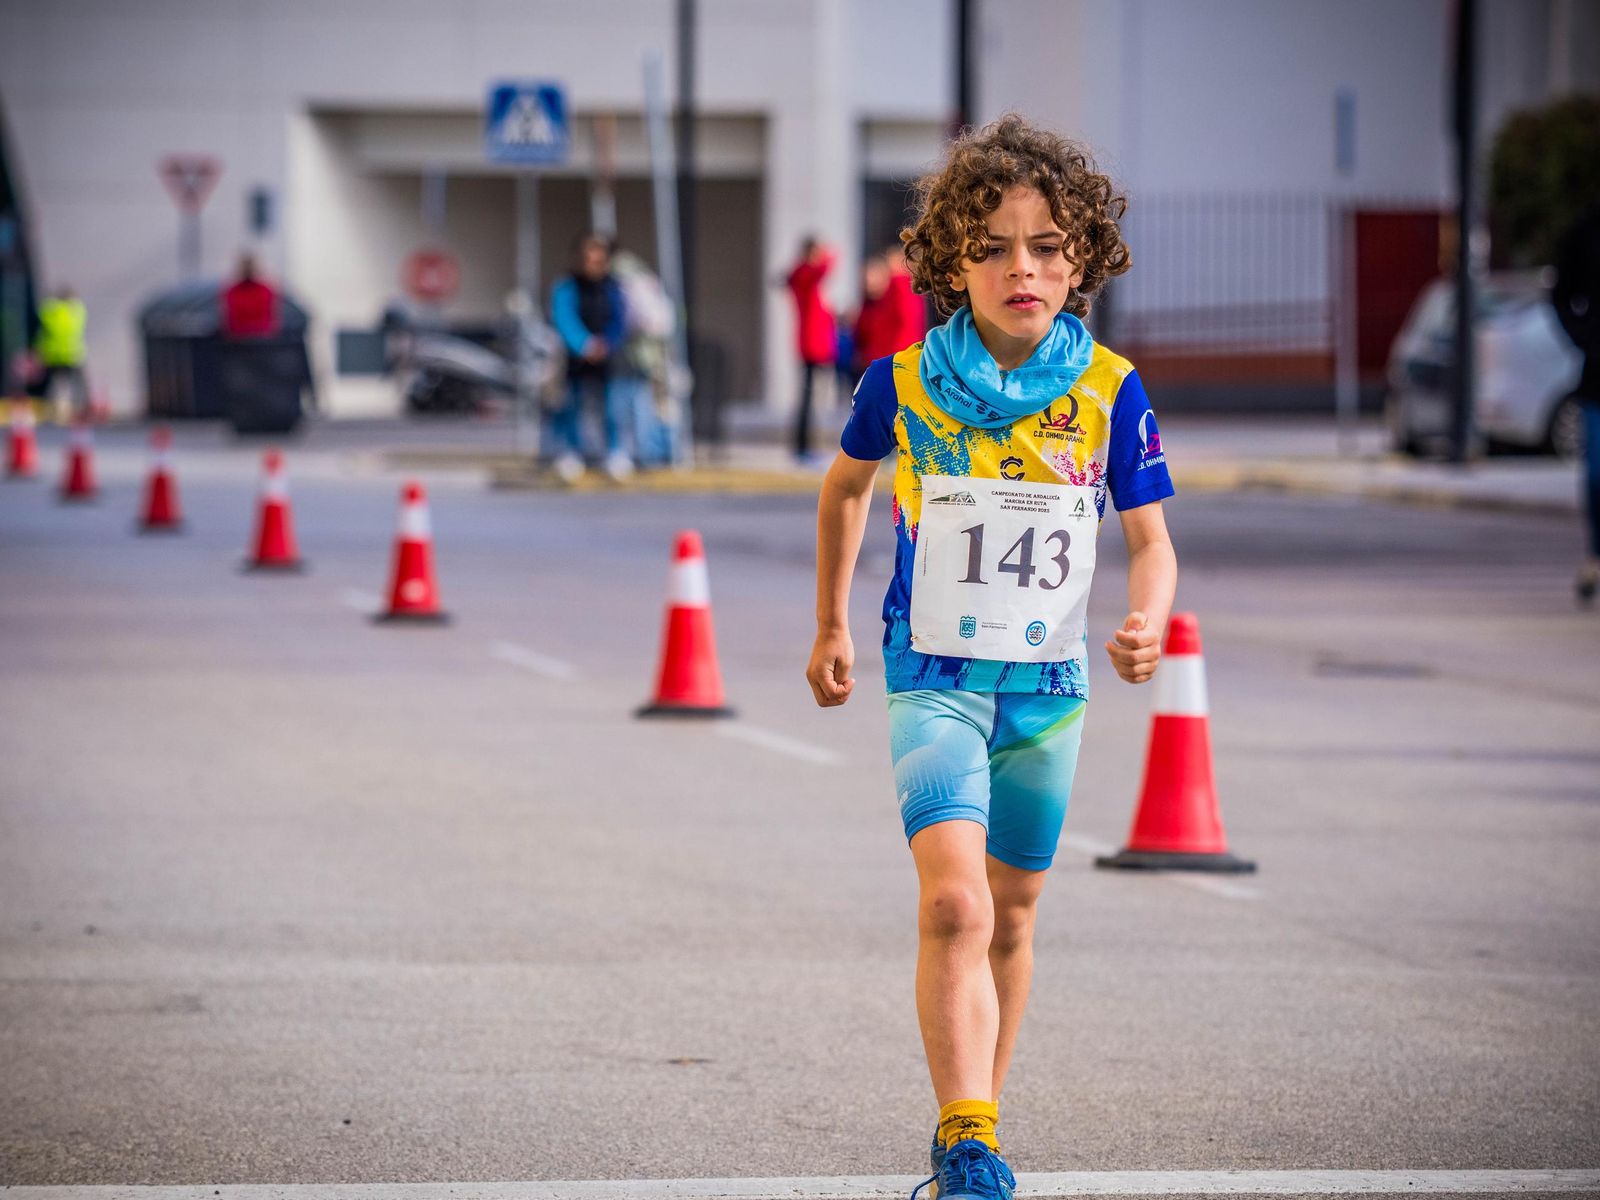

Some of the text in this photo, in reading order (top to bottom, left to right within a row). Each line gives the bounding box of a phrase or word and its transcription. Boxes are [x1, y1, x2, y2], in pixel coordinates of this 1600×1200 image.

[943, 387, 973, 409] Arahal
[1033, 430, 1086, 445] C.D. OHMIO ARAHAL
[991, 490, 1025, 498] CAMPEONATO
[957, 523, 1071, 590] 143
